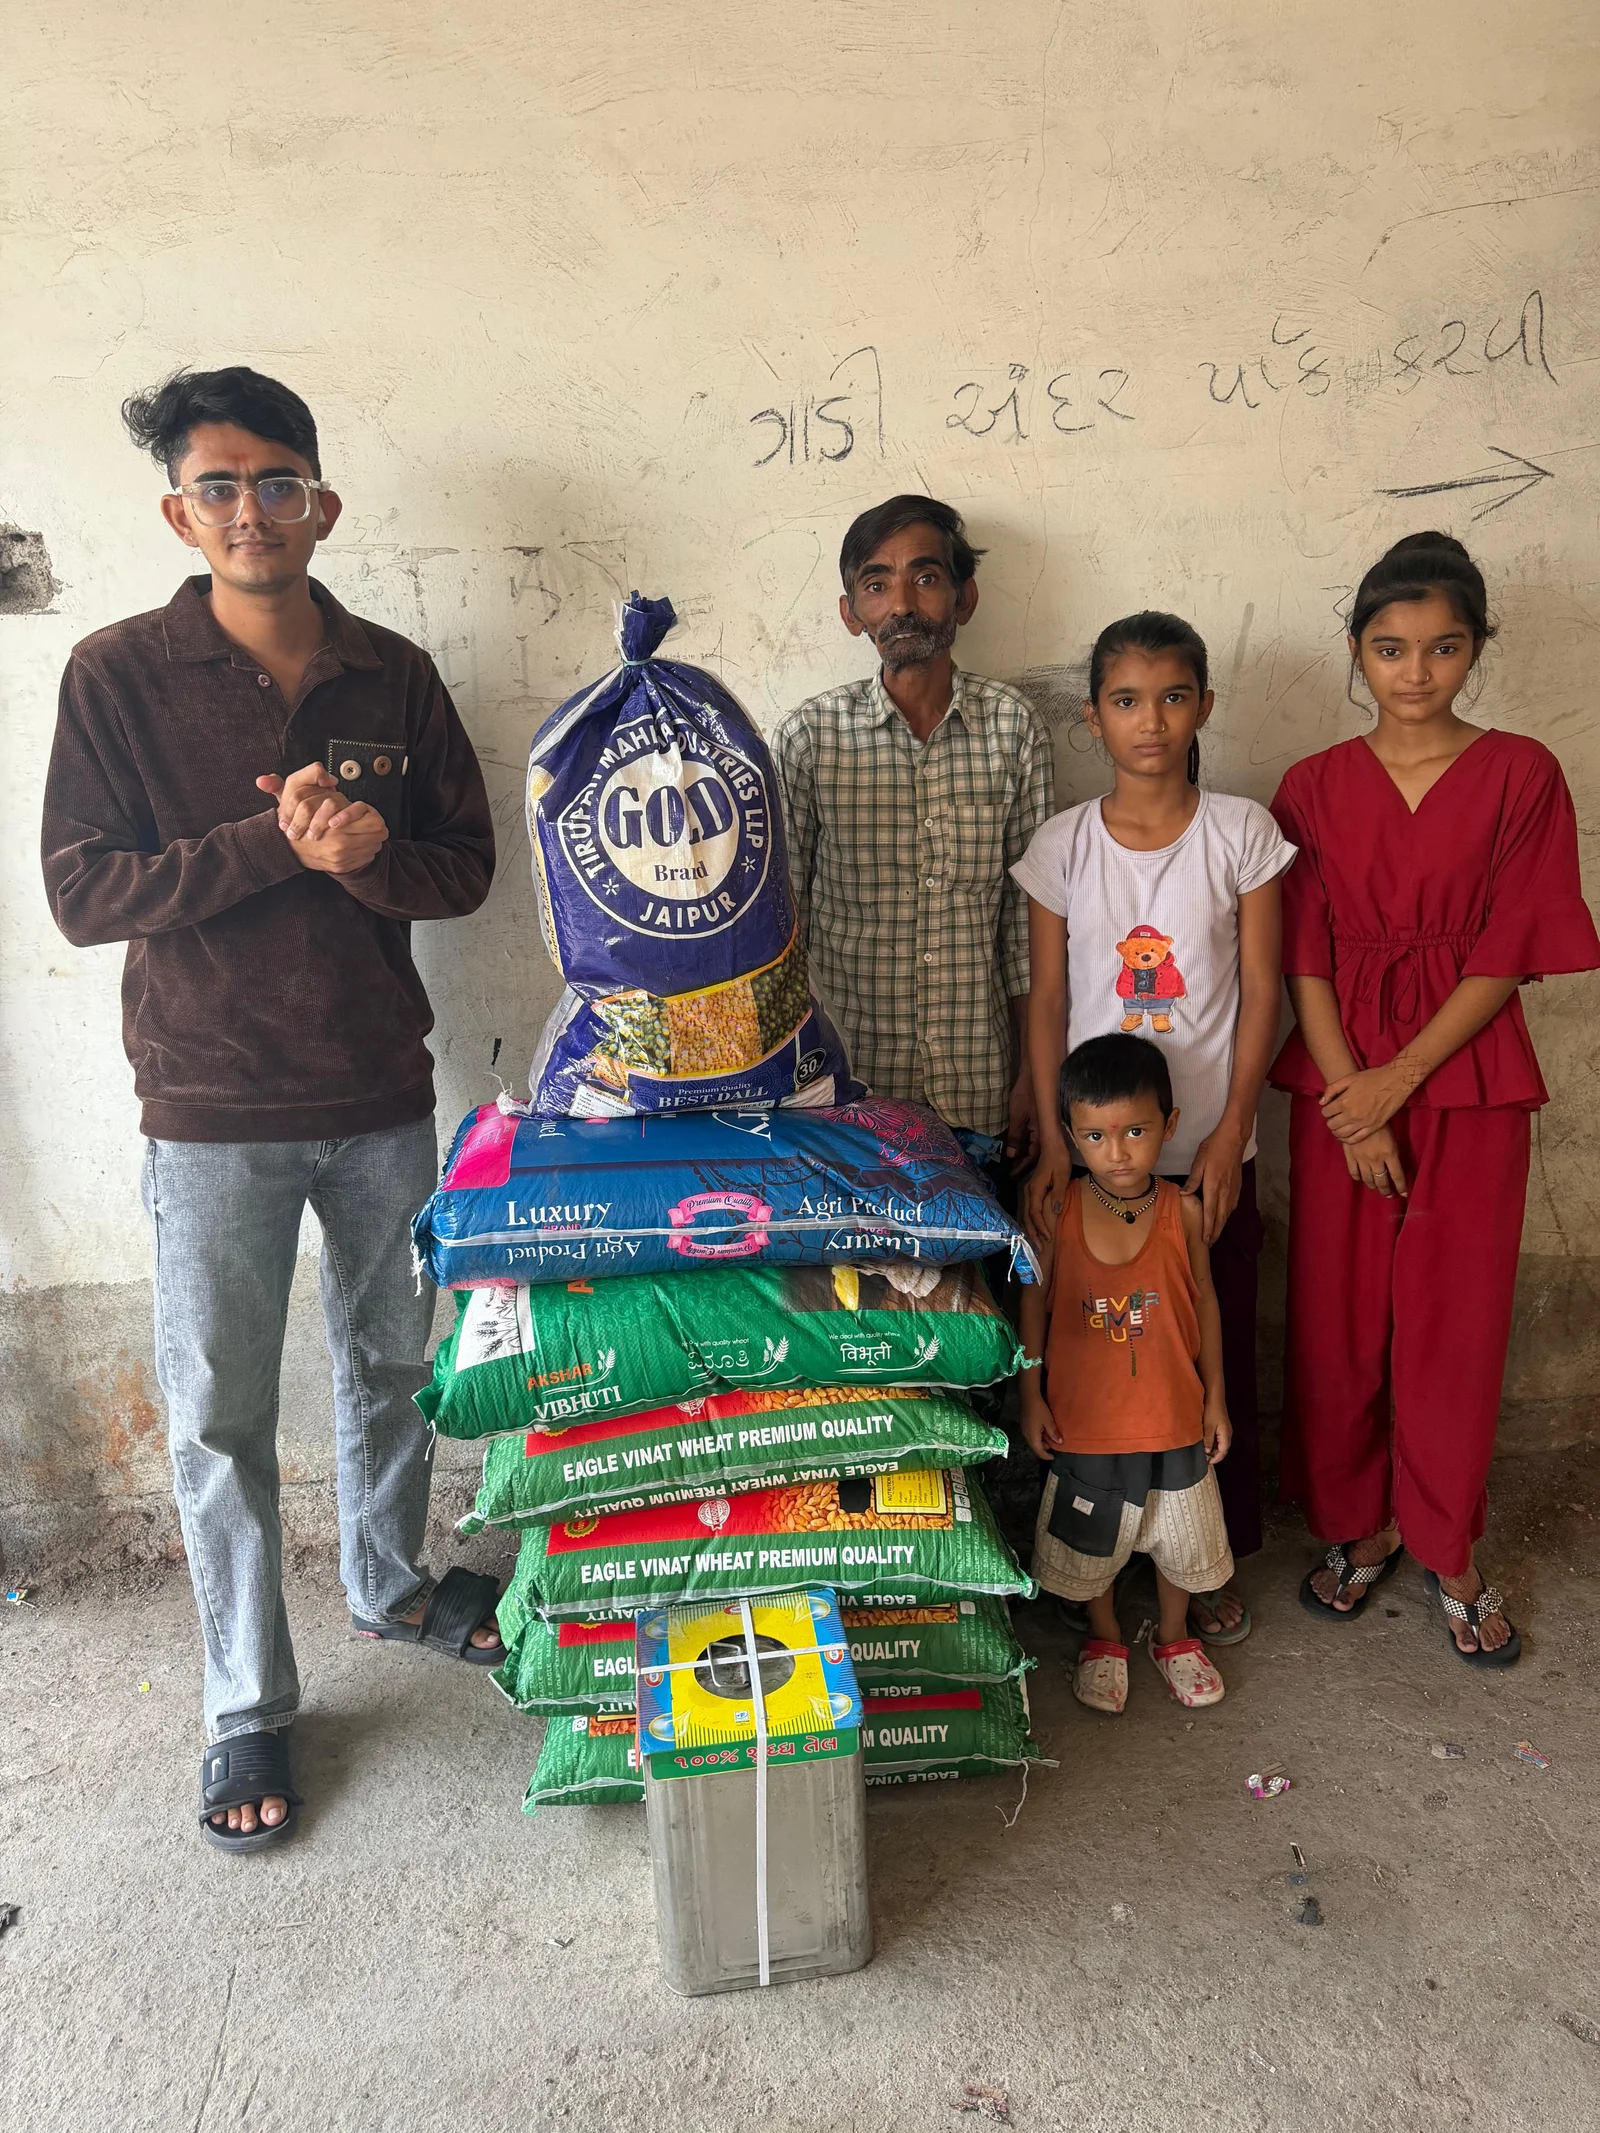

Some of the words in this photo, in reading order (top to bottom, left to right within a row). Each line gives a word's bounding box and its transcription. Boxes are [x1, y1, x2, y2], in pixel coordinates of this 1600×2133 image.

[749, 345, 885, 468] ગાડી
[945, 362, 1136, 440] અંદર
[744, 808, 764, 849] LLP
[638, 891, 737, 930] JAIPUR
[799, 1058, 818, 1078] 30
[658, 1094, 713, 1108] BEST
[716, 1086, 769, 1102] DALL
[678, 1087, 720, 1096] Premium
[720, 1082, 752, 1092] Quality
[686, 1195, 722, 1211] Premium
[723, 1194, 755, 1209] Quality
[797, 1196, 842, 1223] Agri
[852, 1198, 924, 1223] Product
[505, 1200, 613, 1229] Luxury
[596, 1235, 643, 1259] Agri
[826, 1227, 921, 1258] Luxury
[506, 1243, 587, 1266] Product
[1089, 1309, 1144, 1329] GIVE
[1109, 1327, 1144, 1343] UP
[840, 1341, 893, 1366] विभूती
[526, 1362, 594, 1391] AKSHAR
[533, 1385, 623, 1420] VIBHUTI
[562, 1454, 619, 1482] EAGLE
[624, 1442, 673, 1468] VINAT
[676, 1432, 734, 1458] WHEAT
[738, 1421, 817, 1448] PREMIUM
[820, 1414, 894, 1439] QUALITY
[792, 1466, 840, 1482] VINAT
[845, 1461, 899, 1475] EAGLE
[650, 1484, 727, 1506] PREMIUM
[730, 1474, 790, 1494] WHEAT
[574, 1496, 645, 1519] QUALITY
[580, 1560, 636, 1584] EAGLE
[639, 1555, 692, 1578] VINAT
[695, 1550, 754, 1573] WHEAT
[758, 1546, 837, 1569] PREMIUM
[841, 1545, 915, 1566] QUALITY
[862, 1594, 917, 1606] EAGLE
[585, 1607, 648, 1623] UALITY
[850, 1639, 921, 1662] QUALITY
[593, 1656, 636, 1677] EAGL
[869, 1685, 922, 1697] EAGLE
[596, 1701, 636, 1714] LITY
[803, 1735, 838, 1754] તેલ
[879, 1724, 949, 1748] QUALITY
[865, 1773, 905, 1786] VINA
[907, 1770, 959, 1783] EAGLE
